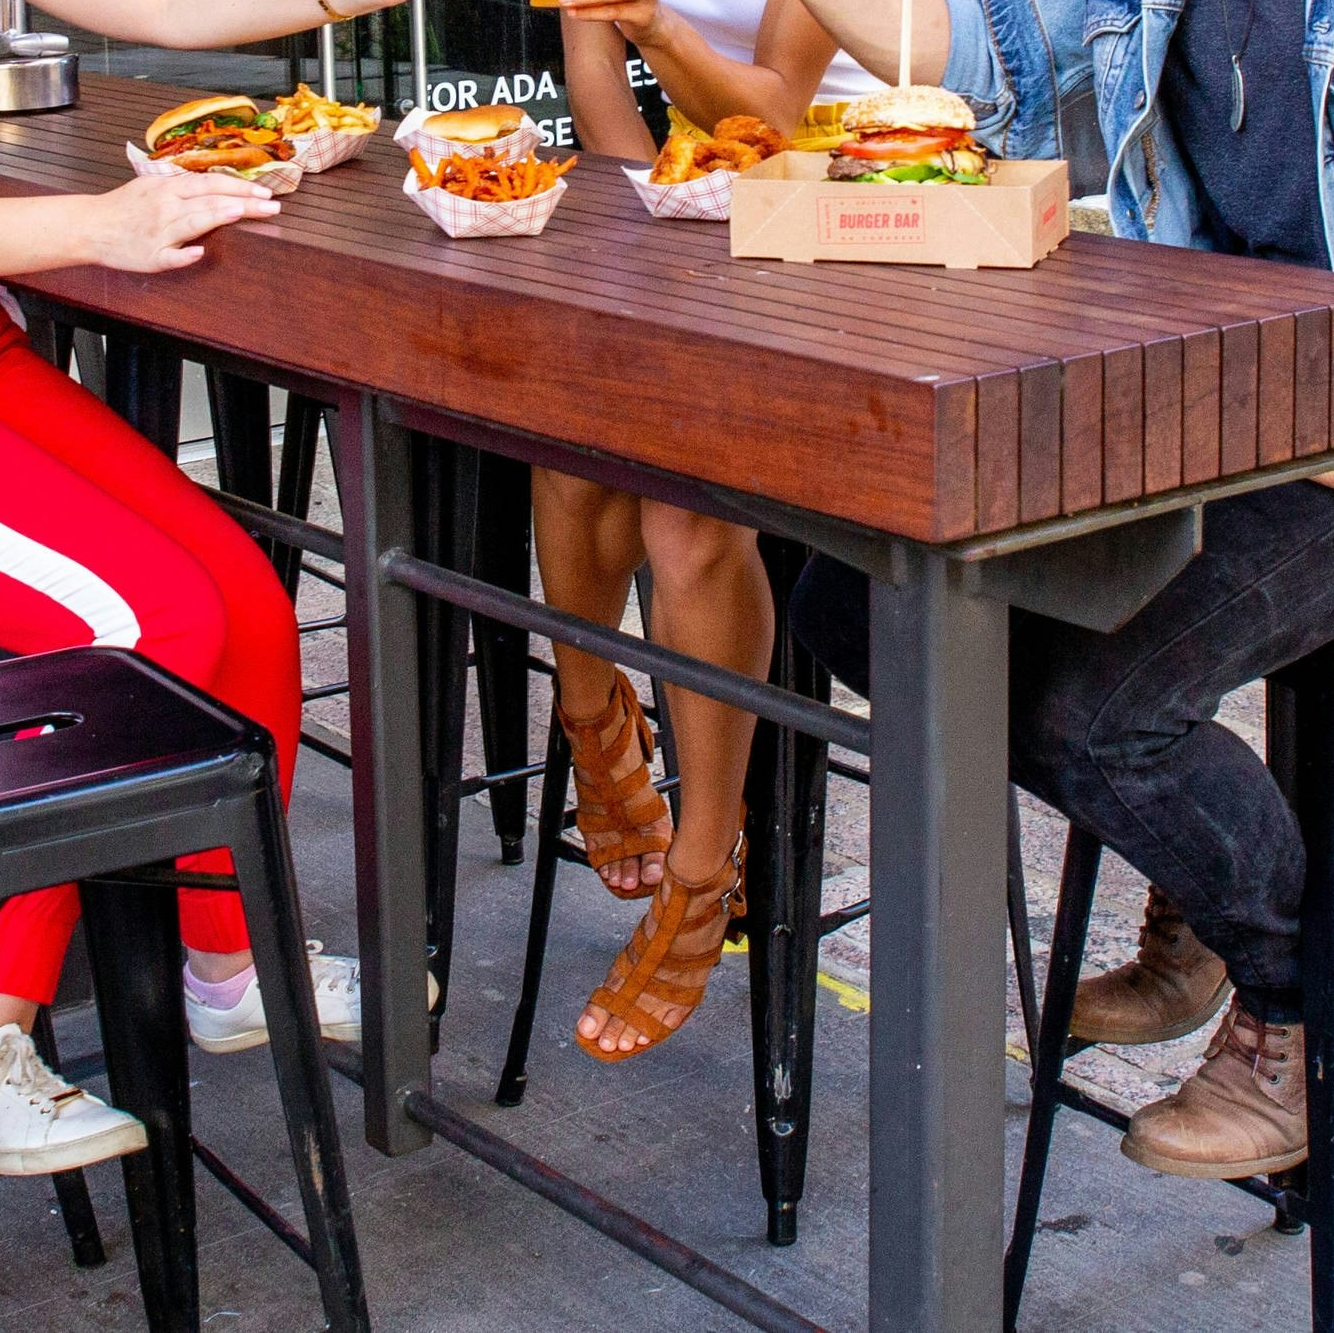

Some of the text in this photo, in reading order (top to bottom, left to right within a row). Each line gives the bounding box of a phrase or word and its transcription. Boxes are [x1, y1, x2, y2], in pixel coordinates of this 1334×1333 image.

[490, 70, 558, 106] ADA
[839, 212, 890, 228] BURGER
[894, 212, 920, 228] BAR
